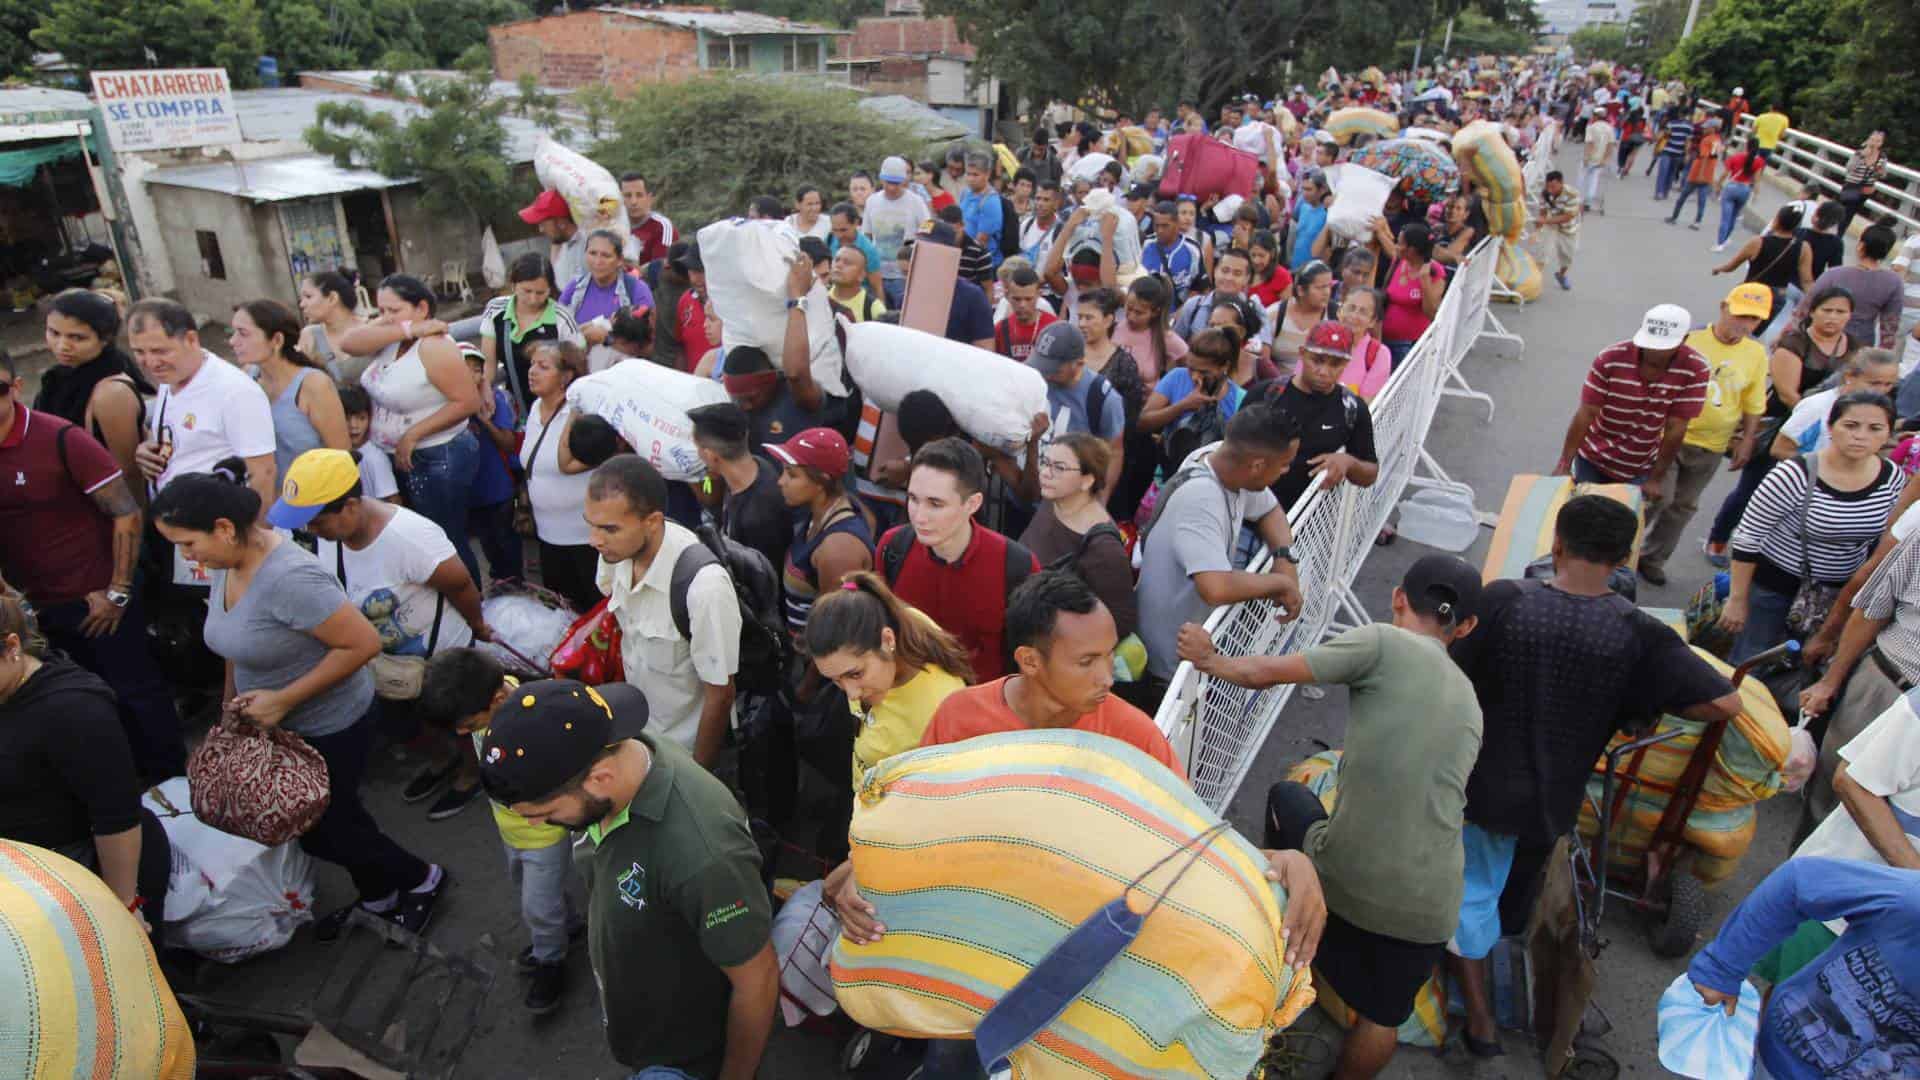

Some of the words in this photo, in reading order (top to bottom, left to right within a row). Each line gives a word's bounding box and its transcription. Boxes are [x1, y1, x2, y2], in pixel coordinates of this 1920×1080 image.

[99, 72, 226, 99] CHATARRERIA
[107, 102, 131, 121] SE
[135, 98, 225, 119] COMPRA
[1647, 327, 1670, 337] NETS
